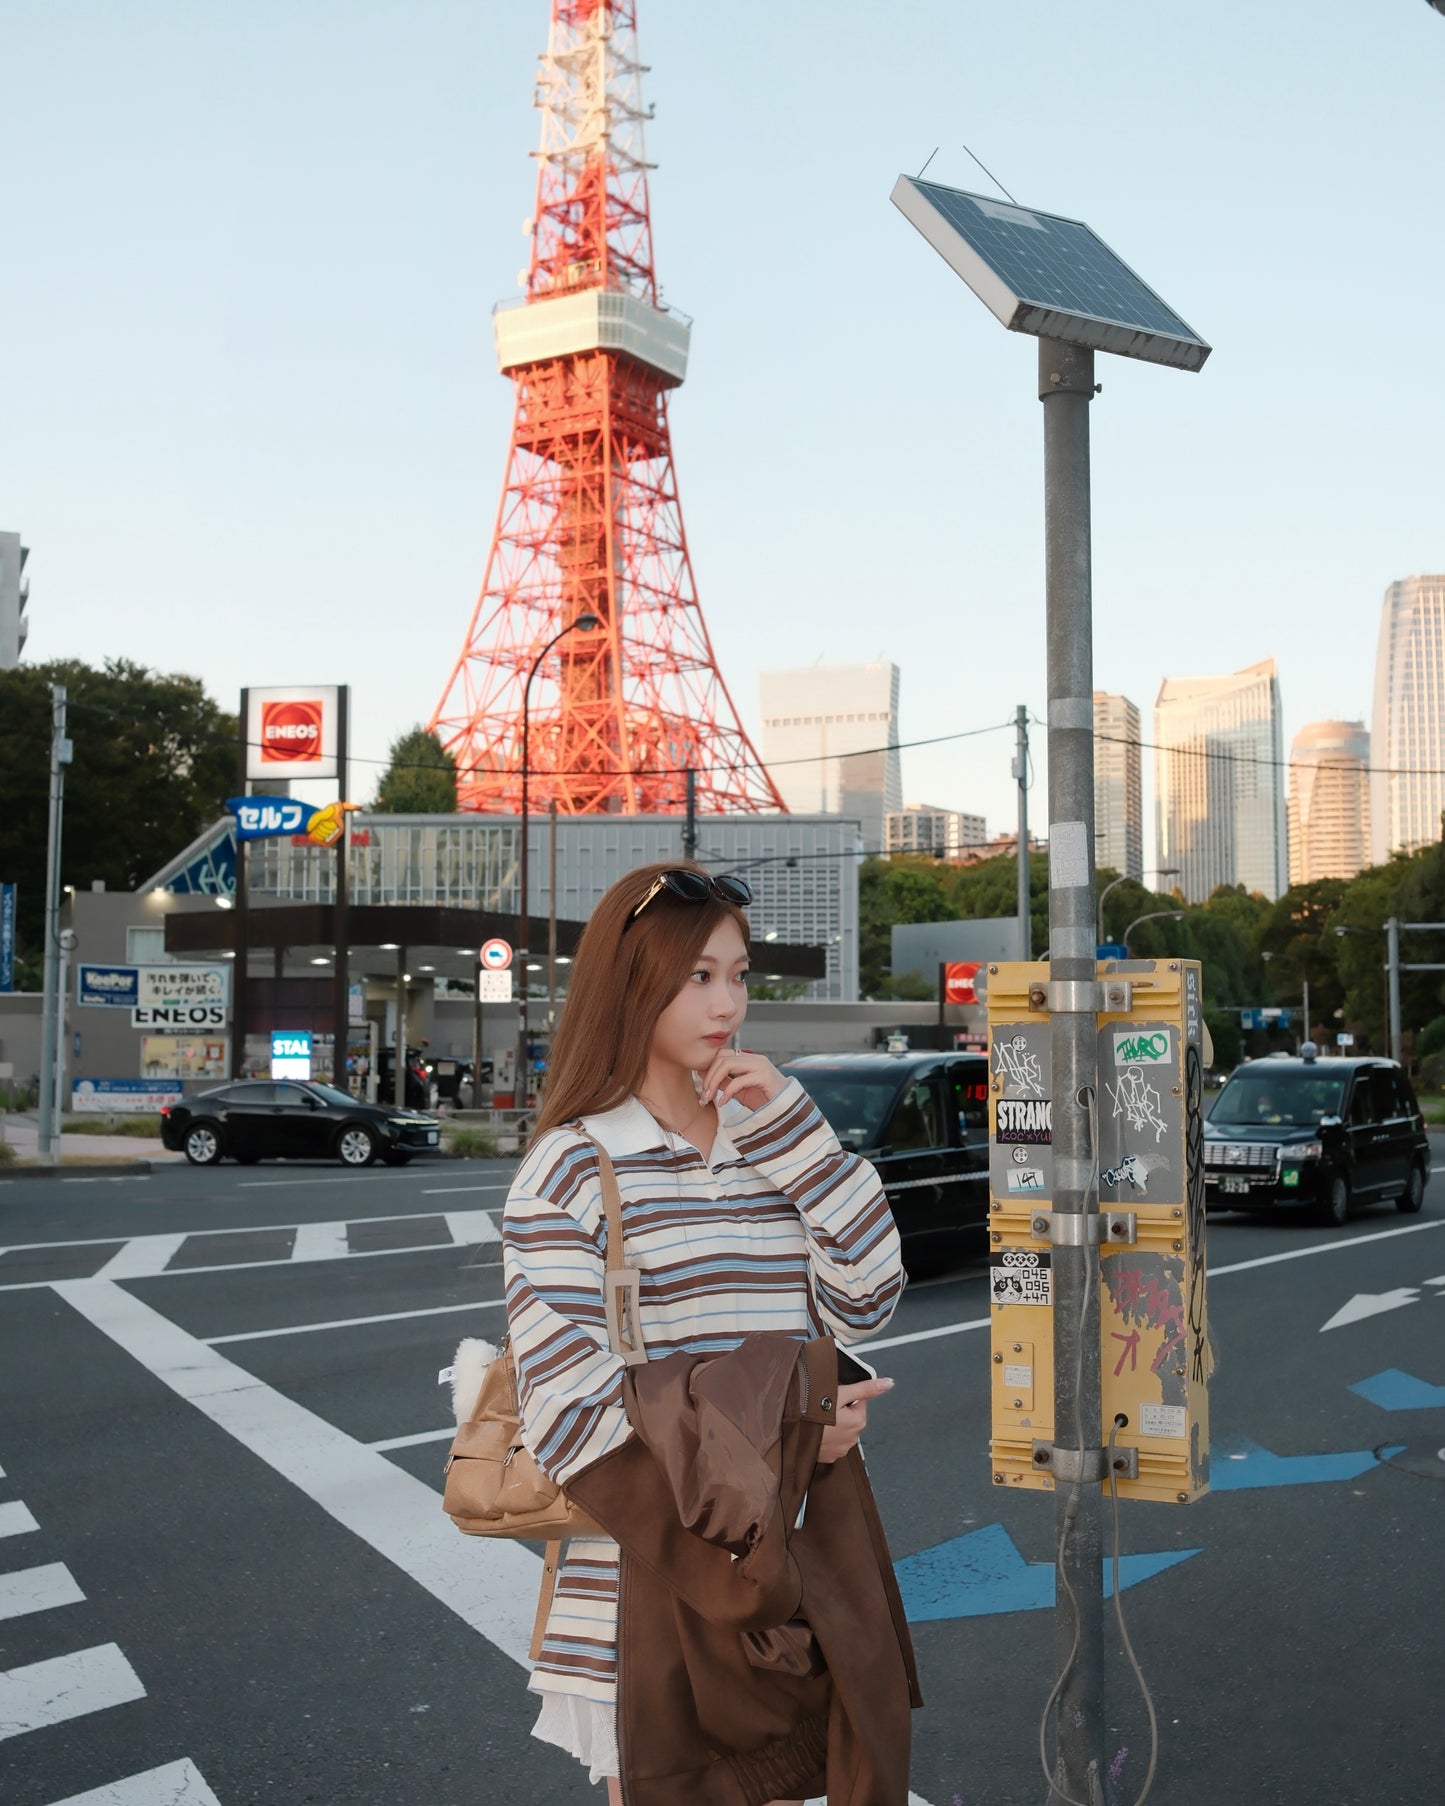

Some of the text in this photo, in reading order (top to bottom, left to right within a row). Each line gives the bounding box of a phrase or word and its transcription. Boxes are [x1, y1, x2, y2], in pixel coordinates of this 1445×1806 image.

[265, 724, 318, 739] ENEOS
[238, 805, 302, 831] セルフ
[135, 1006, 223, 1023] ENEOS
[272, 1039, 311, 1056] STAL
